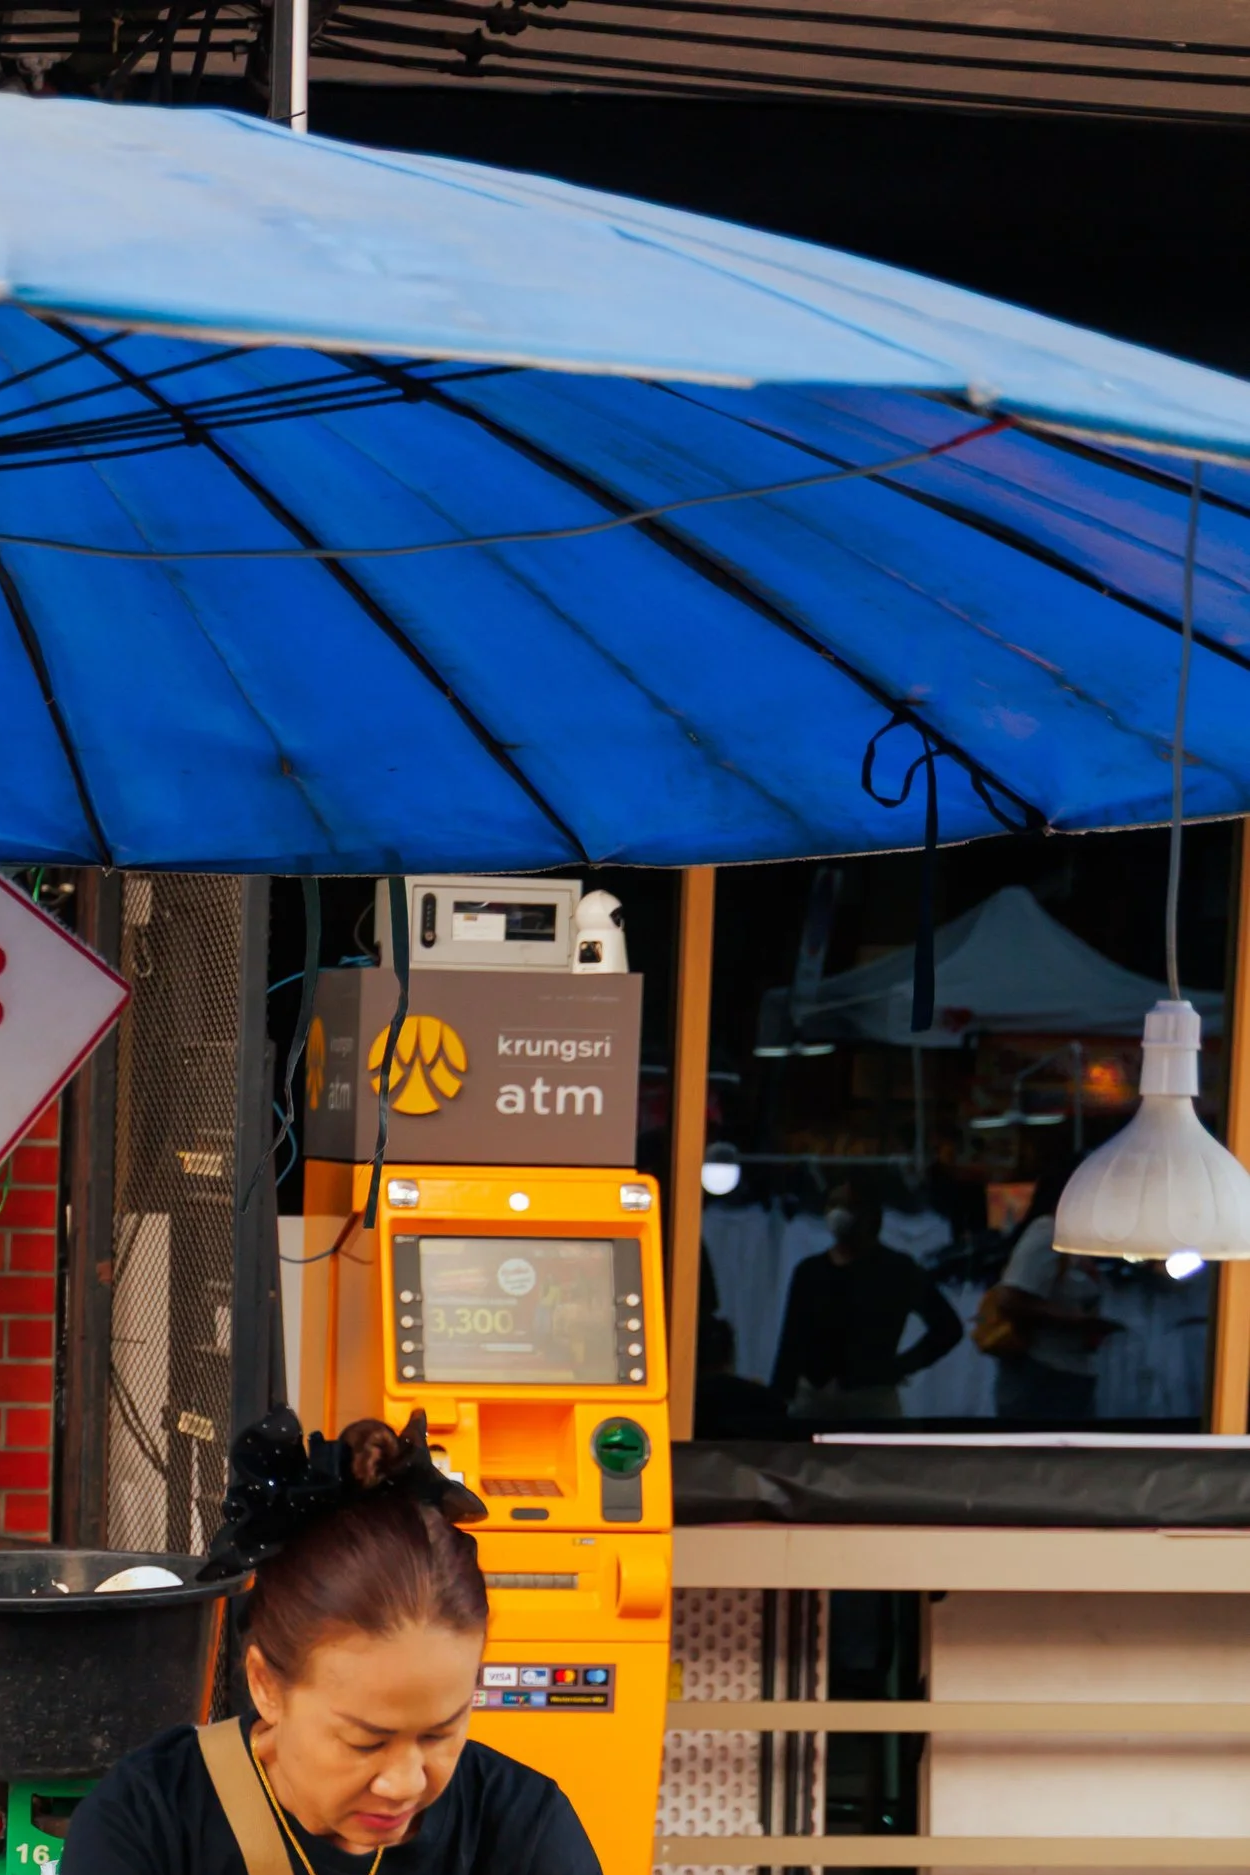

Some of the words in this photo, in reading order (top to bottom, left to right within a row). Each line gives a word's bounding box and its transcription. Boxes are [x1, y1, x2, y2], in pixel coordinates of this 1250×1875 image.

[497, 1034, 611, 1062] krungsri
[495, 1077, 604, 1116] atm
[430, 1307, 514, 1338] 3,300
[16, 1843, 50, 1865] 16
